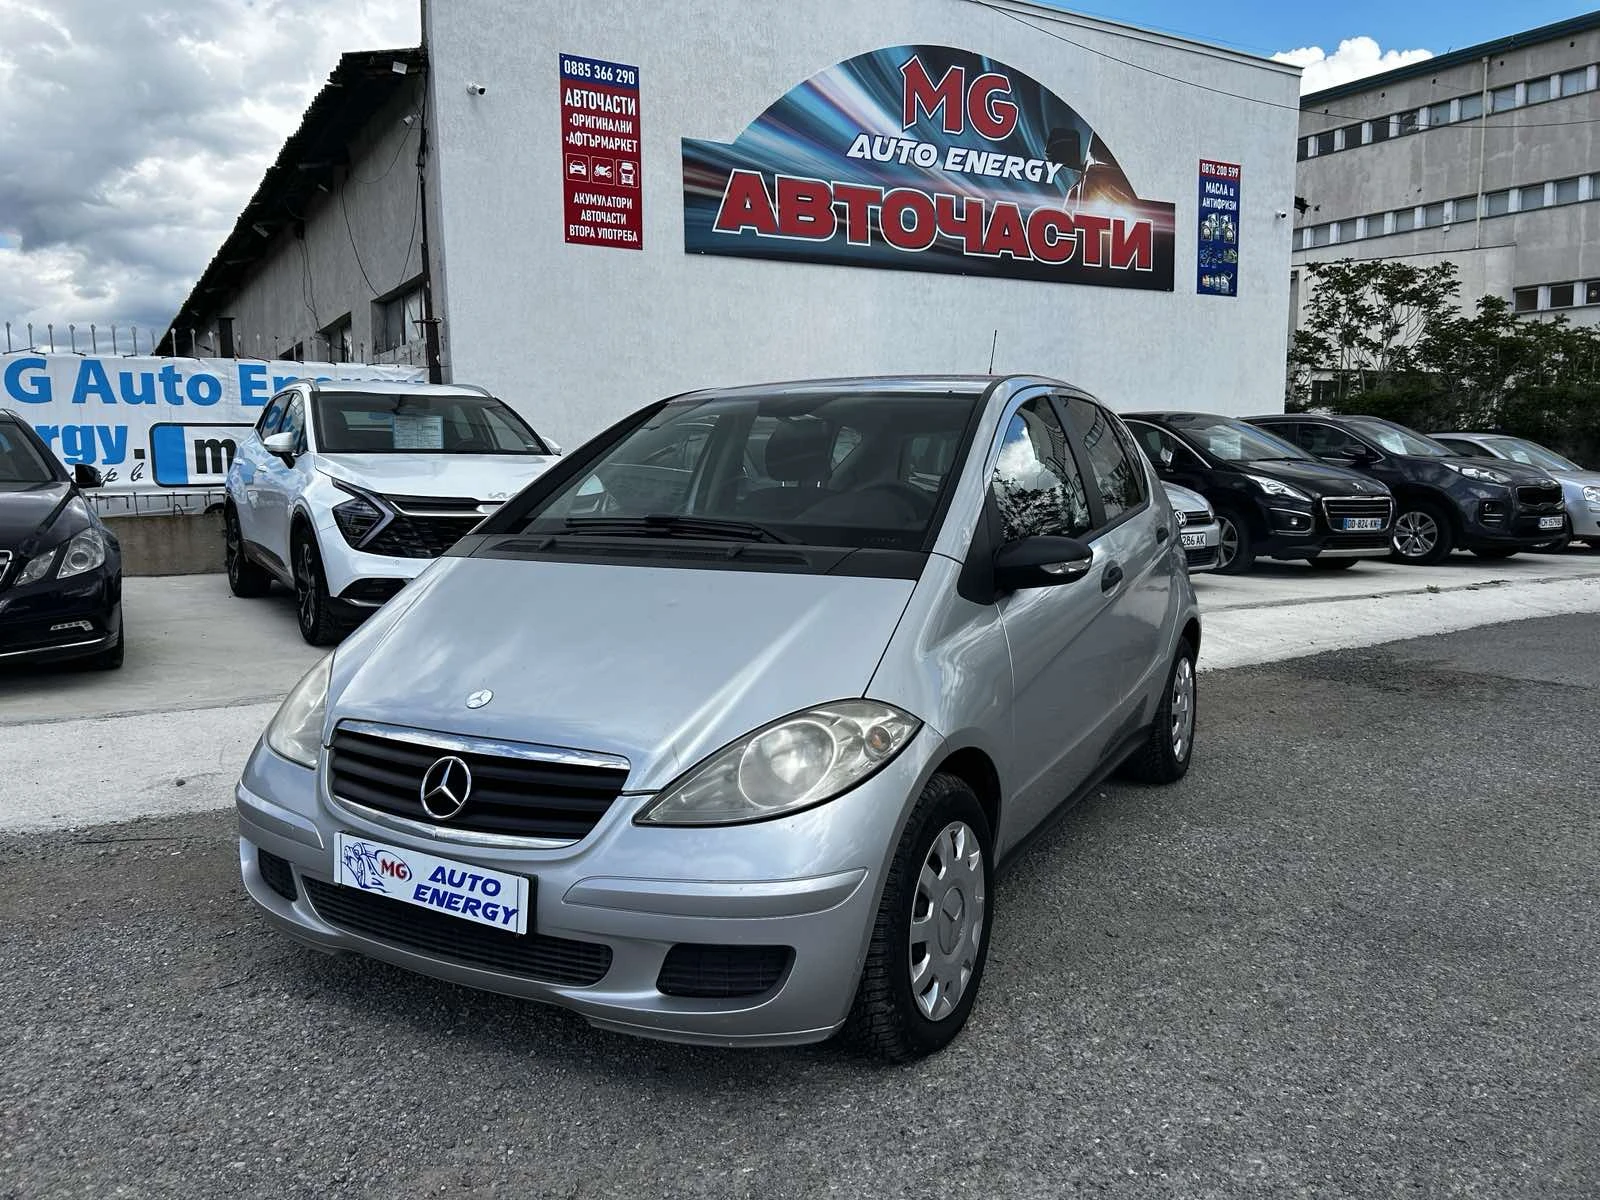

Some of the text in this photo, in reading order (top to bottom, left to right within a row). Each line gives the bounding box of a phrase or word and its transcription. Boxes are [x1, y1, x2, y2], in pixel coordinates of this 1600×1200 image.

[564, 60, 635, 85] 0885 366 290
[565, 88, 636, 116] АВТОЧАСТИ
[900, 54, 1020, 141] MG
[847, 133, 1065, 185] AUTO ENERGY
[1201, 163, 1216, 174] 0876
[573, 192, 633, 209] АКУМУЛАТОРИ
[1206, 181, 1228, 196] МАСЛА
[581, 209, 627, 225] АВТОЧАСТИ
[712, 168, 1154, 272] АВТОЧАСТИ
[569, 225, 638, 242] ВТОРА УПОТРЕБА
[71, 358, 222, 406] Auto
[380, 858, 408, 881] MG
[428, 866, 502, 897] AUTO
[412, 883, 520, 925] ENERGY
